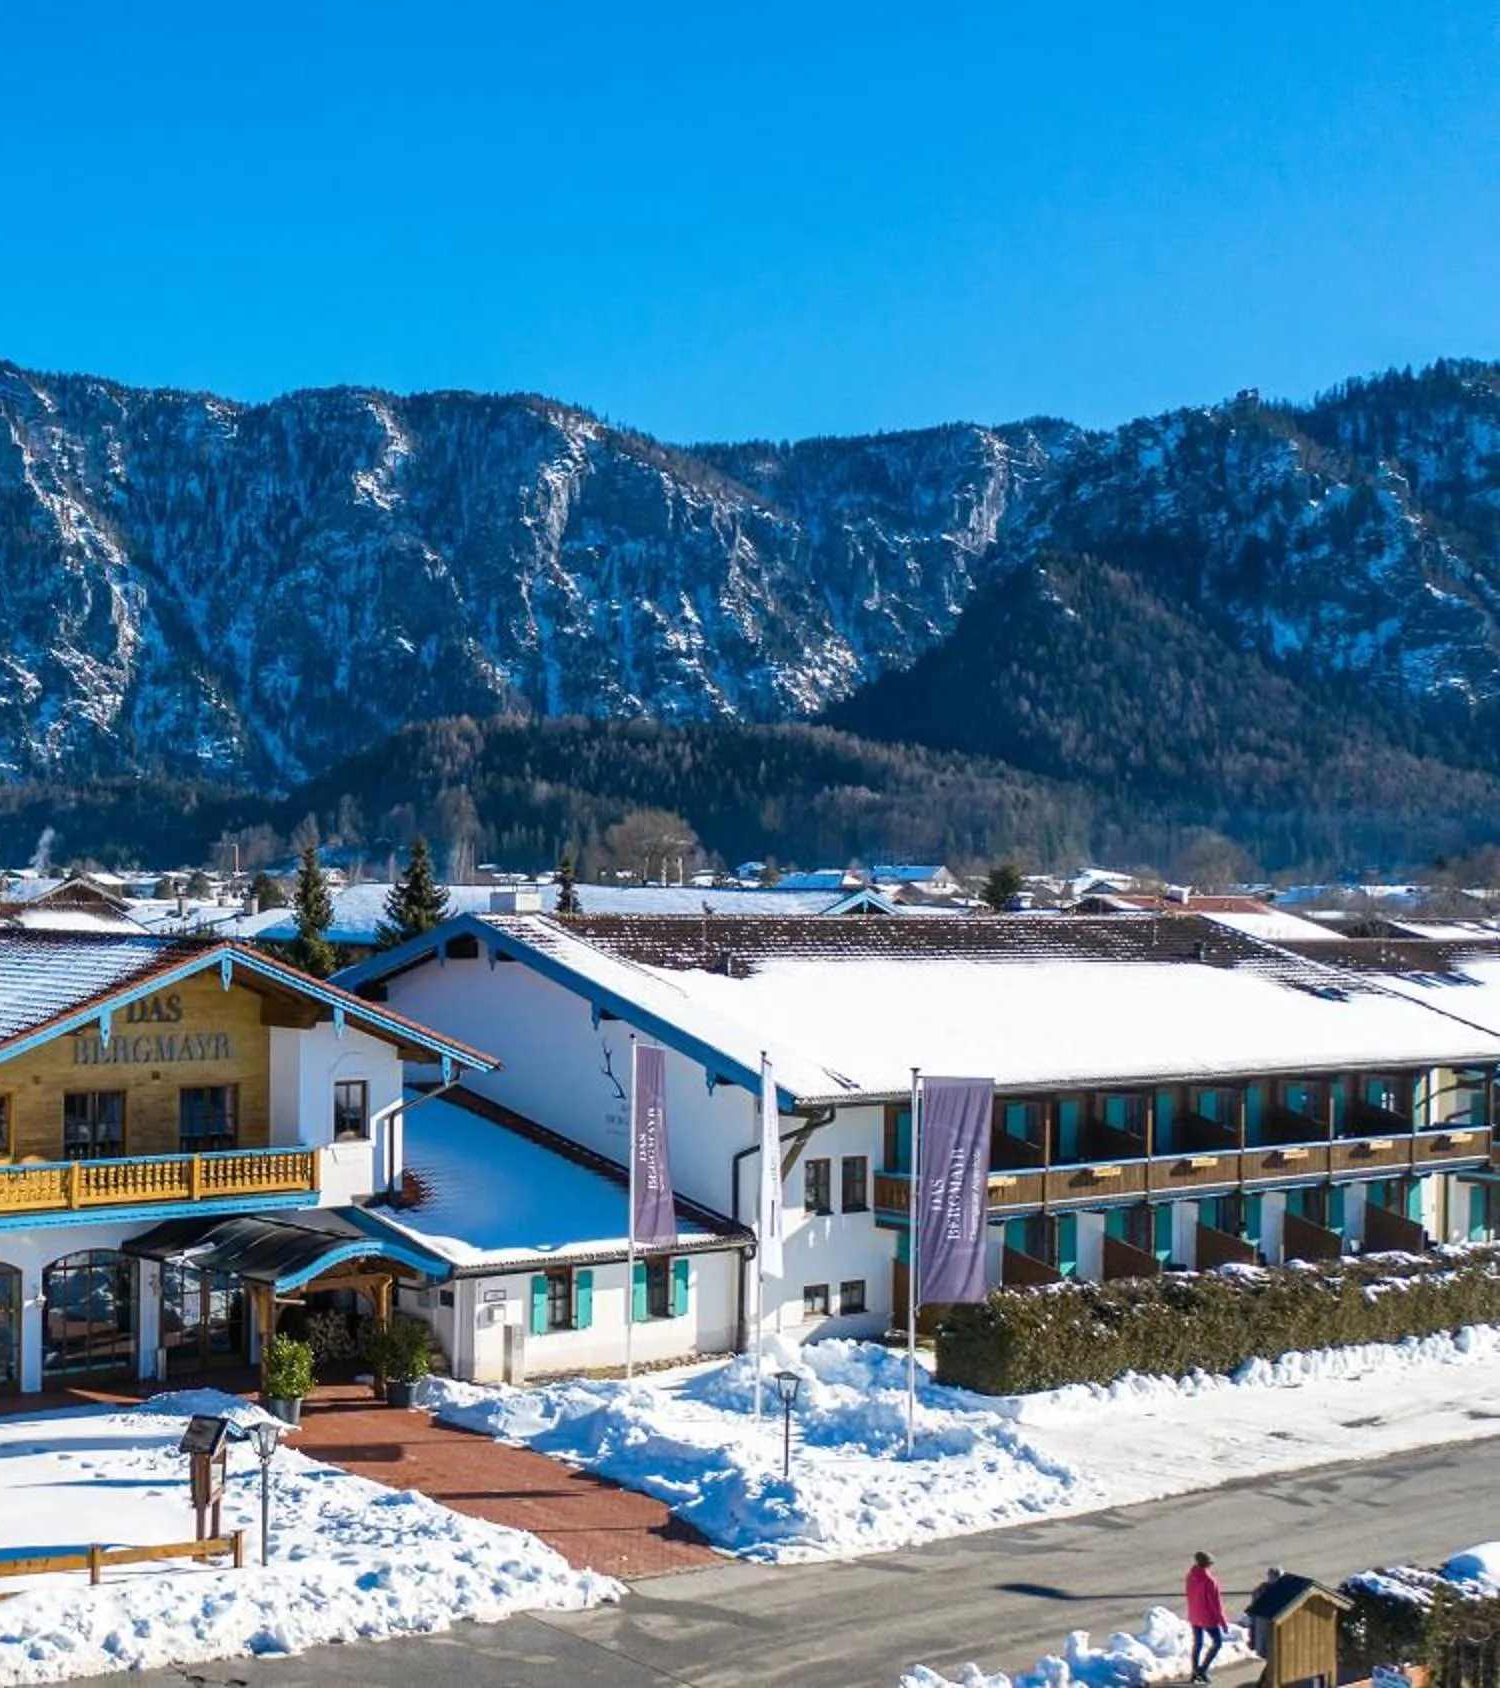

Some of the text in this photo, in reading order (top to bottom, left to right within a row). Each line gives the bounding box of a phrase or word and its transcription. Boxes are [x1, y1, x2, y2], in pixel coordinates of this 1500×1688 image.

[126, 994, 183, 1024] DAS
[73, 1031, 234, 1065] BERGMAYR
[931, 1178, 945, 1211] DAS
